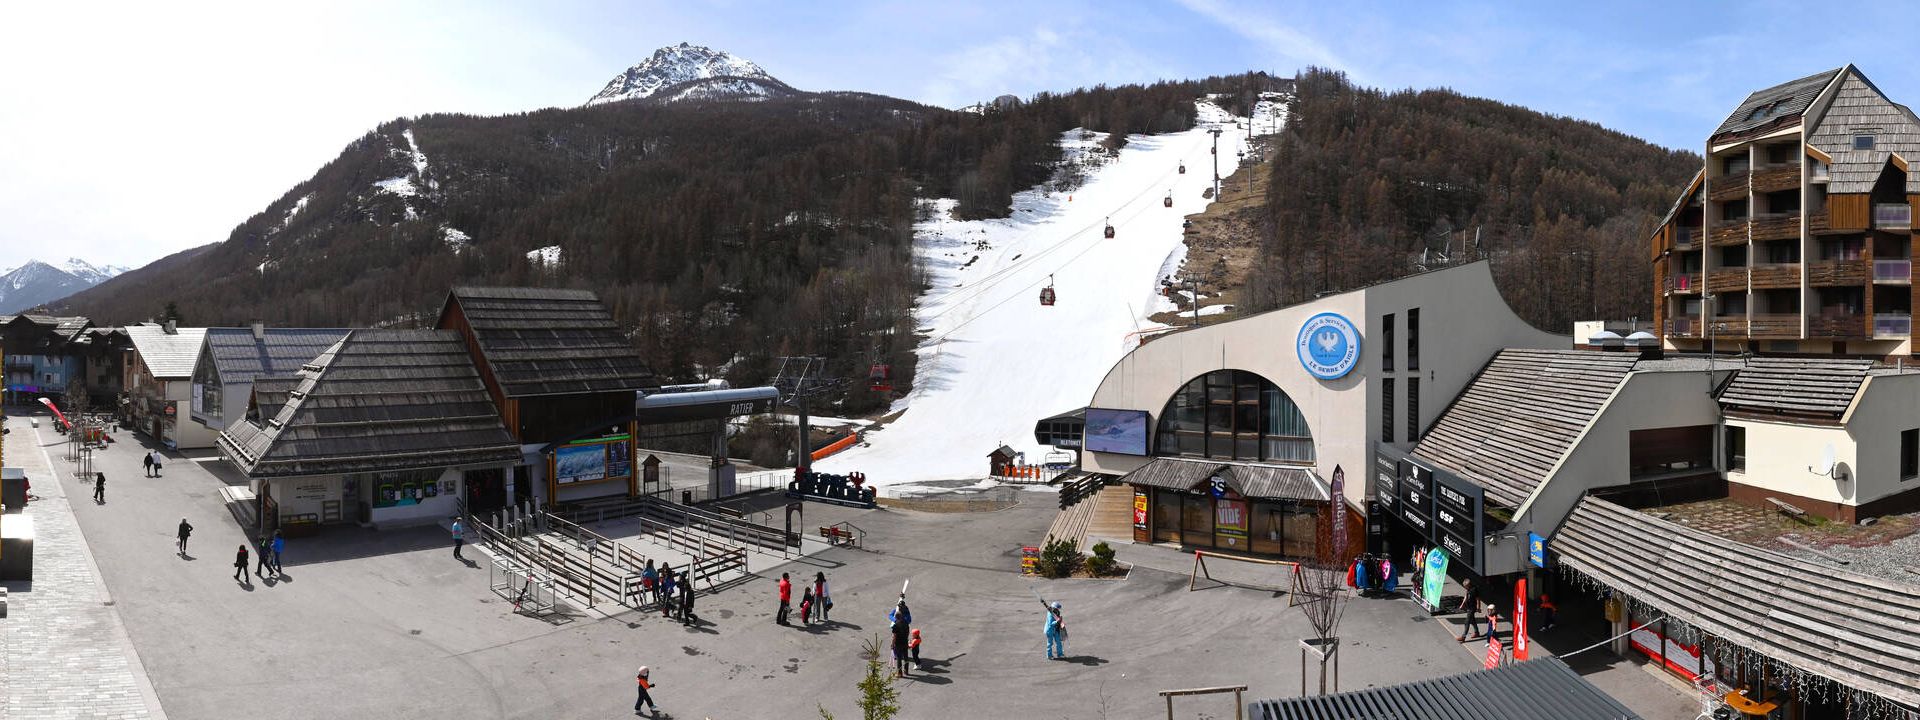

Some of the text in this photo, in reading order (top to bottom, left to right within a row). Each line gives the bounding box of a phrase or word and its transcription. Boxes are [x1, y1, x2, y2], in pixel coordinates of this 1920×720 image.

[1325, 319, 1345, 330] Services
[1309, 361, 1317, 370] LE
[1340, 344, 1355, 369] D'AIGLE
[730, 403, 754, 415] RATIER
[1217, 508, 1240, 525] VIDE
[1443, 534, 1462, 555] sherpa
